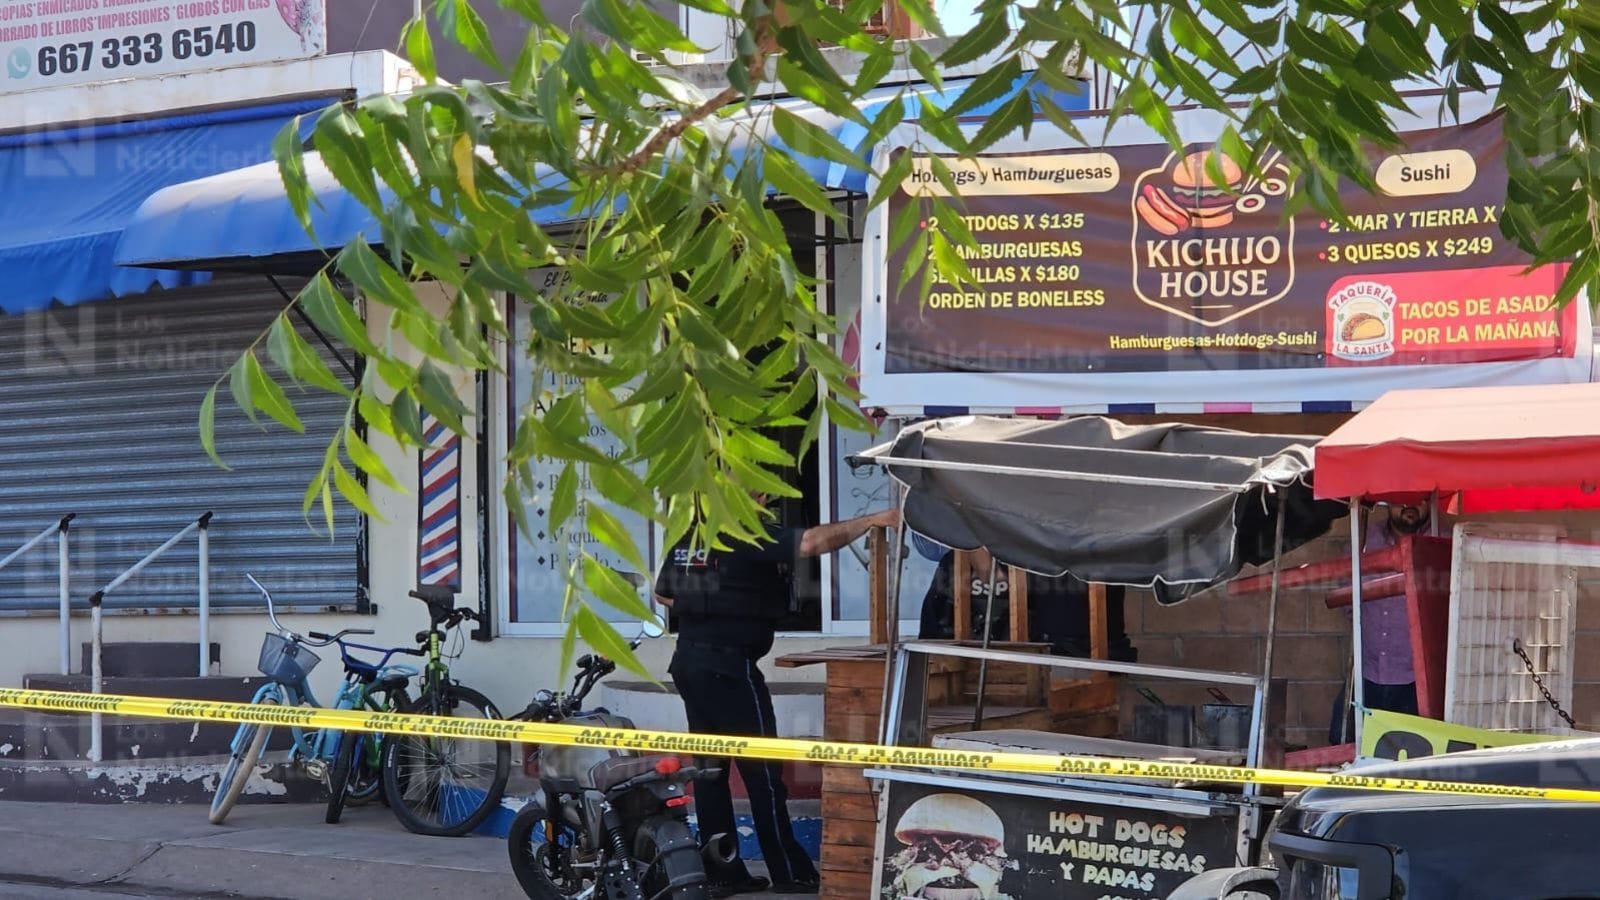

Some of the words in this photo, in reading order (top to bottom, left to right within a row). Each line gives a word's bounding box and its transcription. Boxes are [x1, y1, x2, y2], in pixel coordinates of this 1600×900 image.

[0, 3, 33, 20] OPIAS
[41, 21, 54, 37] DE
[37, 40, 94, 76] 667
[101, 32, 164, 69] 333
[172, 21, 257, 60] 6540
[980, 170, 988, 185] y
[992, 165, 1114, 183] Hamburguesas
[1400, 163, 1451, 184] Sushi
[928, 216, 939, 232] 2
[1023, 213, 1035, 230] X
[1039, 212, 1085, 231] $135
[1347, 213, 1389, 232] MAR
[1392, 212, 1406, 229] Y
[1409, 206, 1479, 229] TIERRA
[1483, 204, 1498, 224] X
[948, 241, 1083, 260] AMBURGUESAS
[1146, 235, 1281, 268] KICHIJO
[1327, 245, 1340, 262] 3
[1344, 241, 1421, 264] QUESOS
[1426, 239, 1439, 257] X
[1443, 235, 1494, 258] $249
[1020, 266, 1032, 282] X
[1035, 264, 1079, 283] $180
[1159, 269, 1269, 299] HOUSE
[929, 292, 986, 309] ORDEN
[991, 291, 1013, 308] DE
[1017, 289, 1106, 307] BONELESS
[1399, 301, 1460, 320] TACOS
[1466, 298, 1491, 317] DE
[1401, 325, 1440, 345] POR
[1446, 323, 1467, 343] LA
[1475, 319, 1561, 341] MAÑANA
[1335, 342, 1350, 354] LA
[1353, 342, 1391, 356] SANTA
[1050, 811, 1104, 836] HOT
[1114, 818, 1187, 849] DOGS
[1026, 834, 1208, 874] HAMBURGUESAS
[1059, 862, 1074, 881] Y
[1082, 864, 1156, 892] PAPAS
